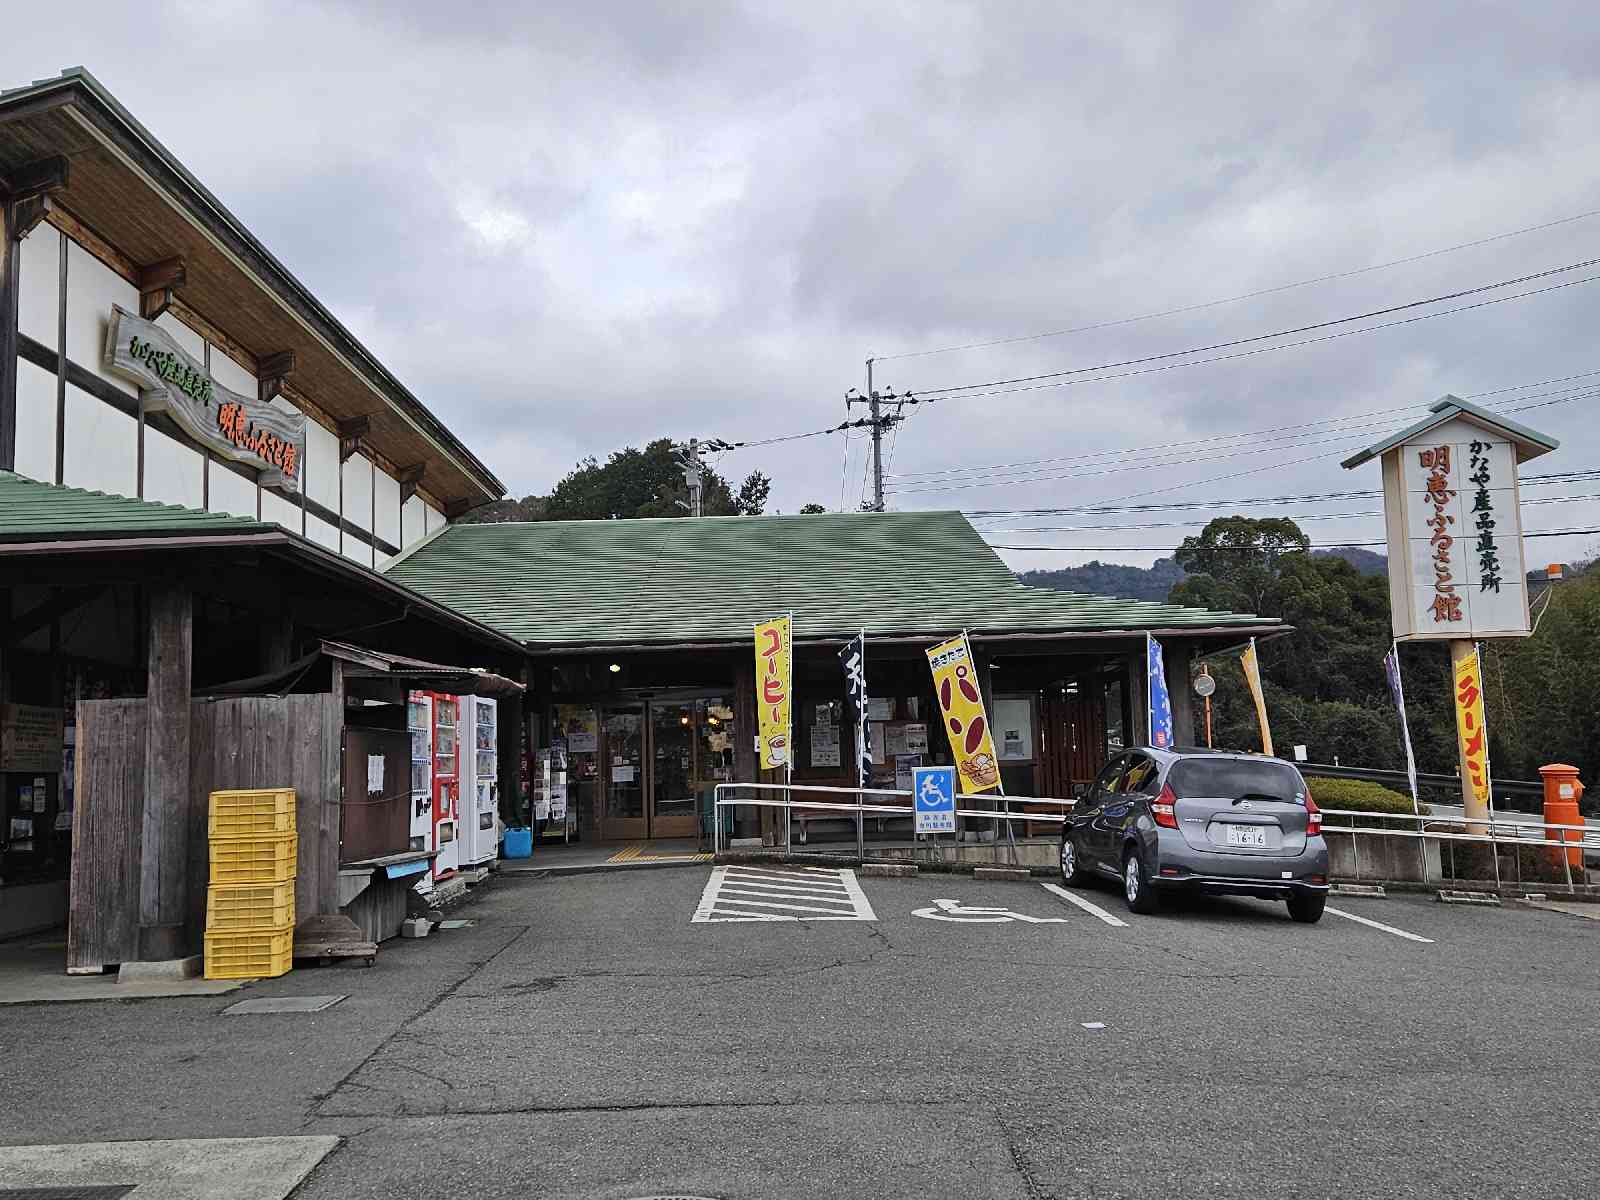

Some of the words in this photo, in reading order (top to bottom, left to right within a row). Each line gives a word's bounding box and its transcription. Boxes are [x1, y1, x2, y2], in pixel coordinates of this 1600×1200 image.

[1418, 445, 1464, 623] 明恵ふるさと館
[1468, 440, 1503, 594] かなや産品直売所
[761, 628, 786, 724] コーヒー
[940, 664, 985, 755] パン
[1457, 674, 1483, 787] ラーメン
